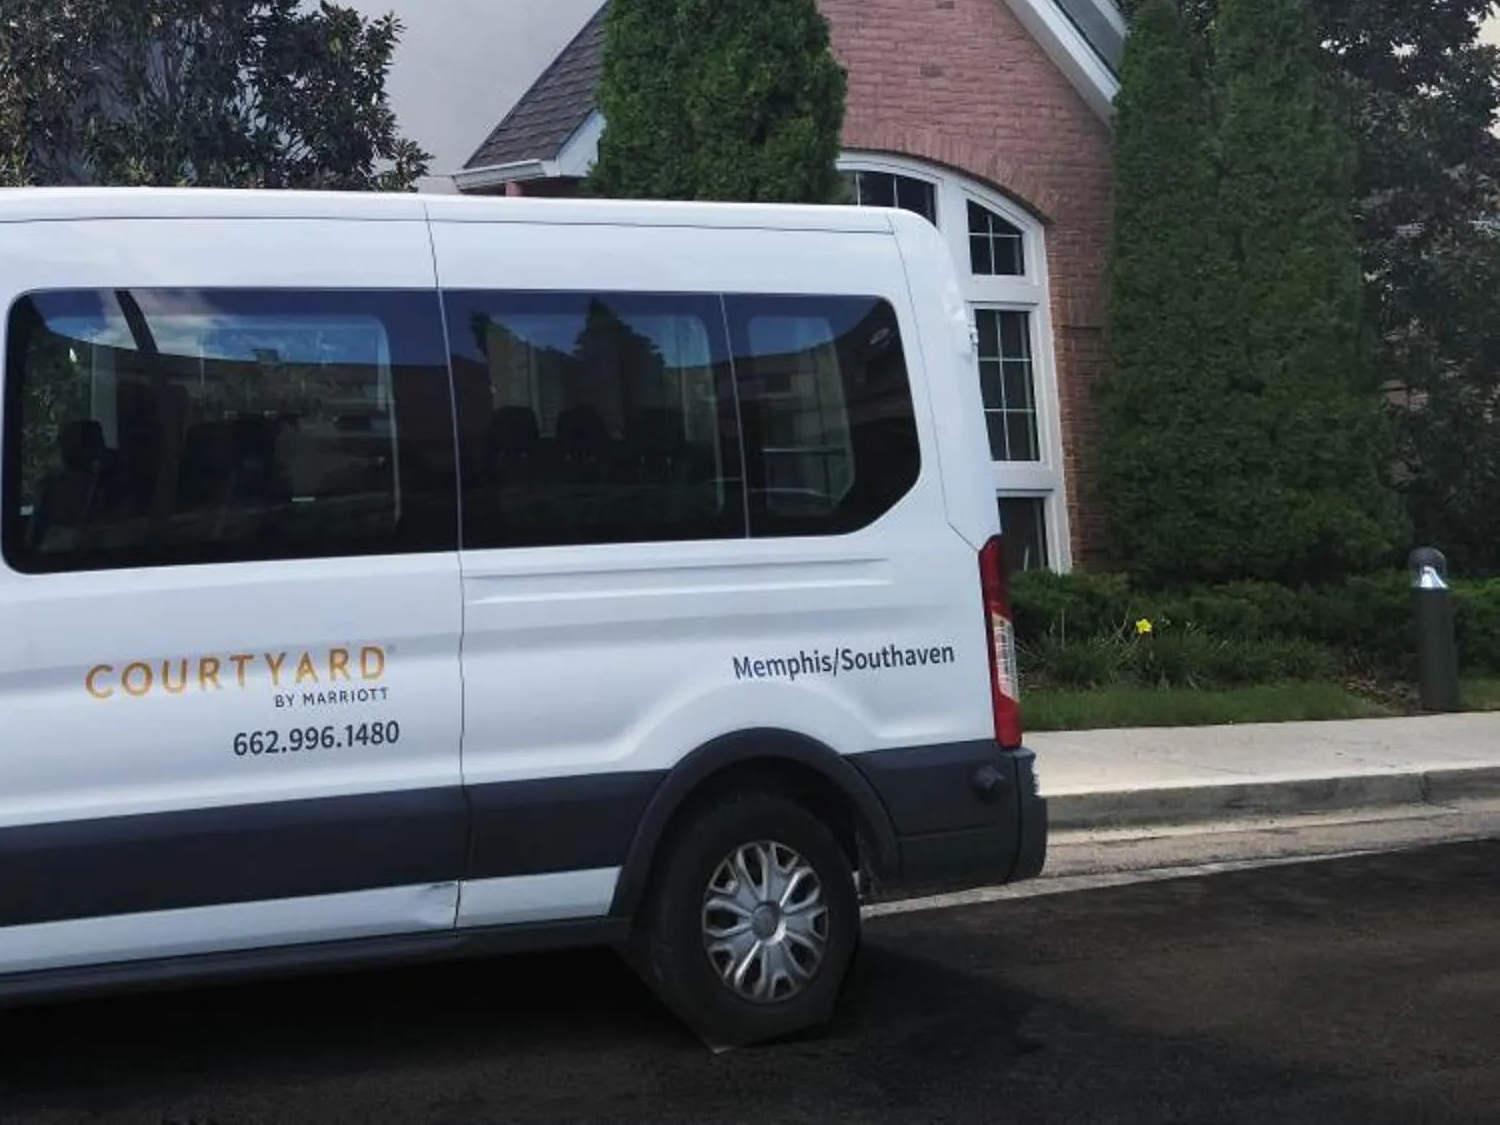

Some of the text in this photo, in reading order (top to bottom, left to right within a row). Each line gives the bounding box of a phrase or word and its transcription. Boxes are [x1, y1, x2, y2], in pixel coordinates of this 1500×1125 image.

[84, 644, 386, 699] COURTYARD
[732, 643, 955, 681] Memphis/Southaven
[275, 686, 390, 709] BY MARRIOTT
[232, 719, 400, 757] 662.996.1480
